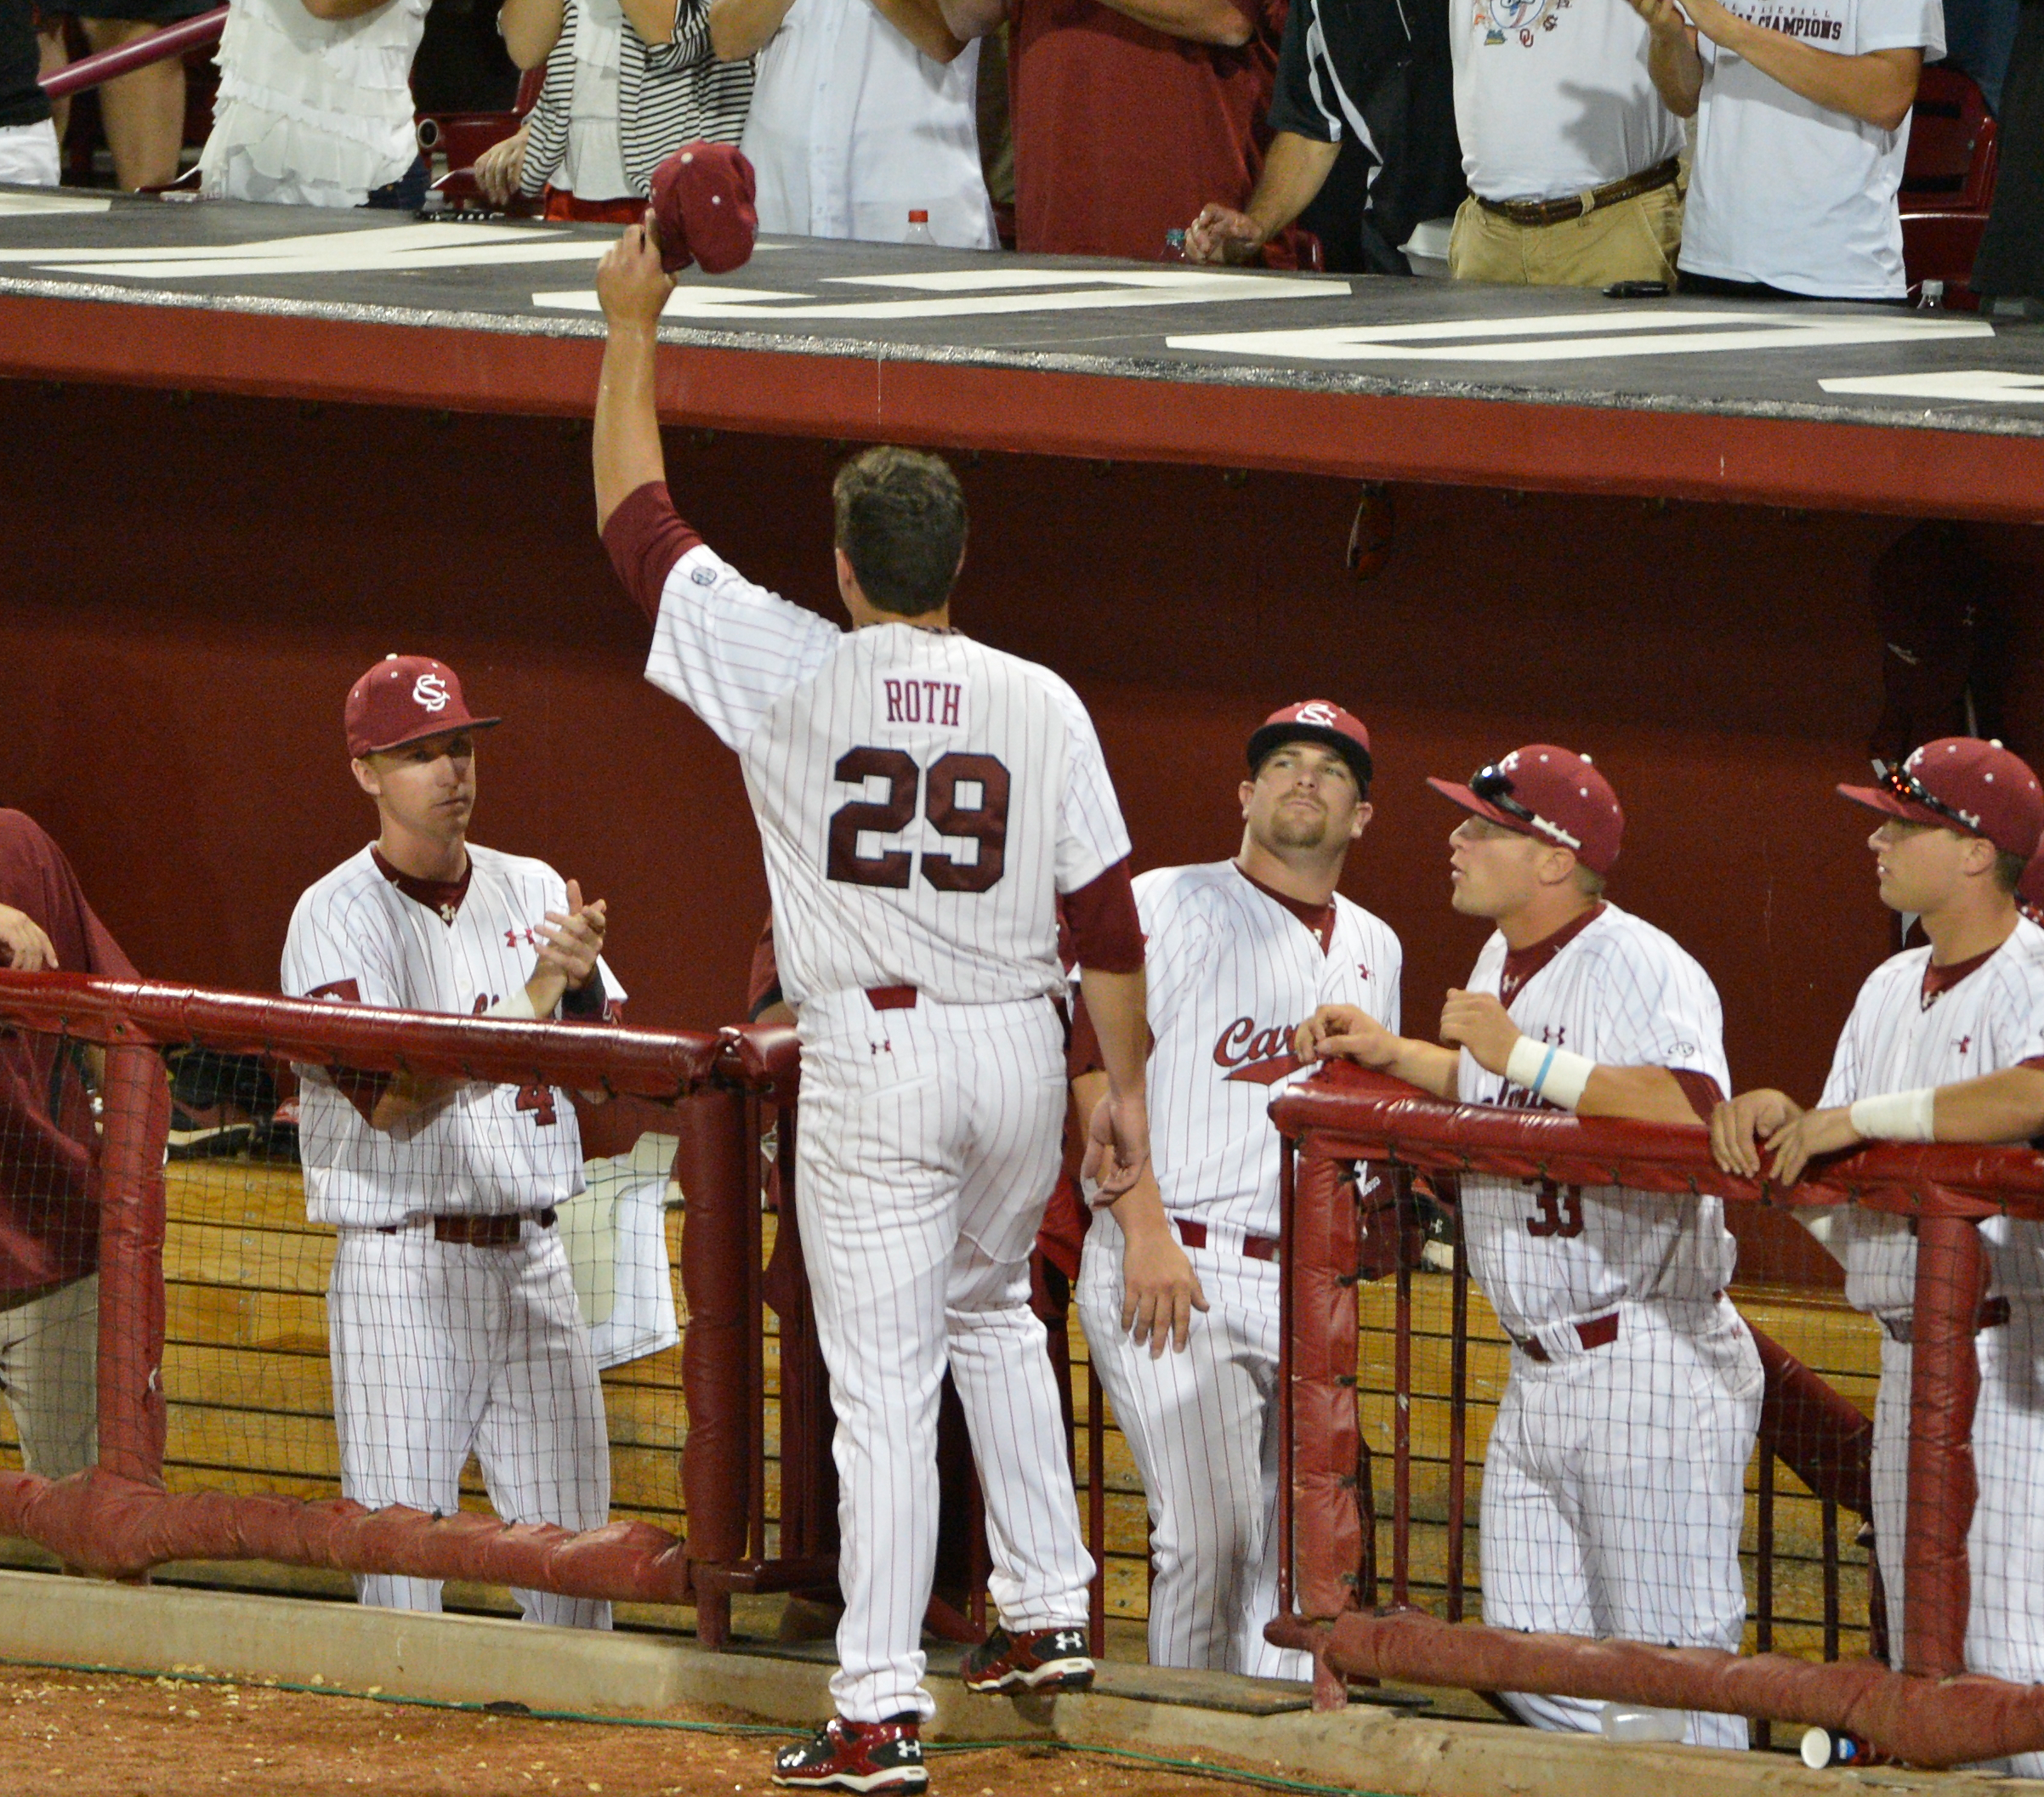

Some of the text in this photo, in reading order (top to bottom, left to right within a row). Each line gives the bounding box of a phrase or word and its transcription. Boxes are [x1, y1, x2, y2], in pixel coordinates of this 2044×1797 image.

[1750, 4, 1831, 18] BASEBALL
[1757, 14, 1842, 40] CHAMPIONS
[883, 678, 962, 727] ROTH
[826, 745, 1012, 893] 29
[1212, 1016, 1298, 1068] Car
[514, 1084, 557, 1126] 4
